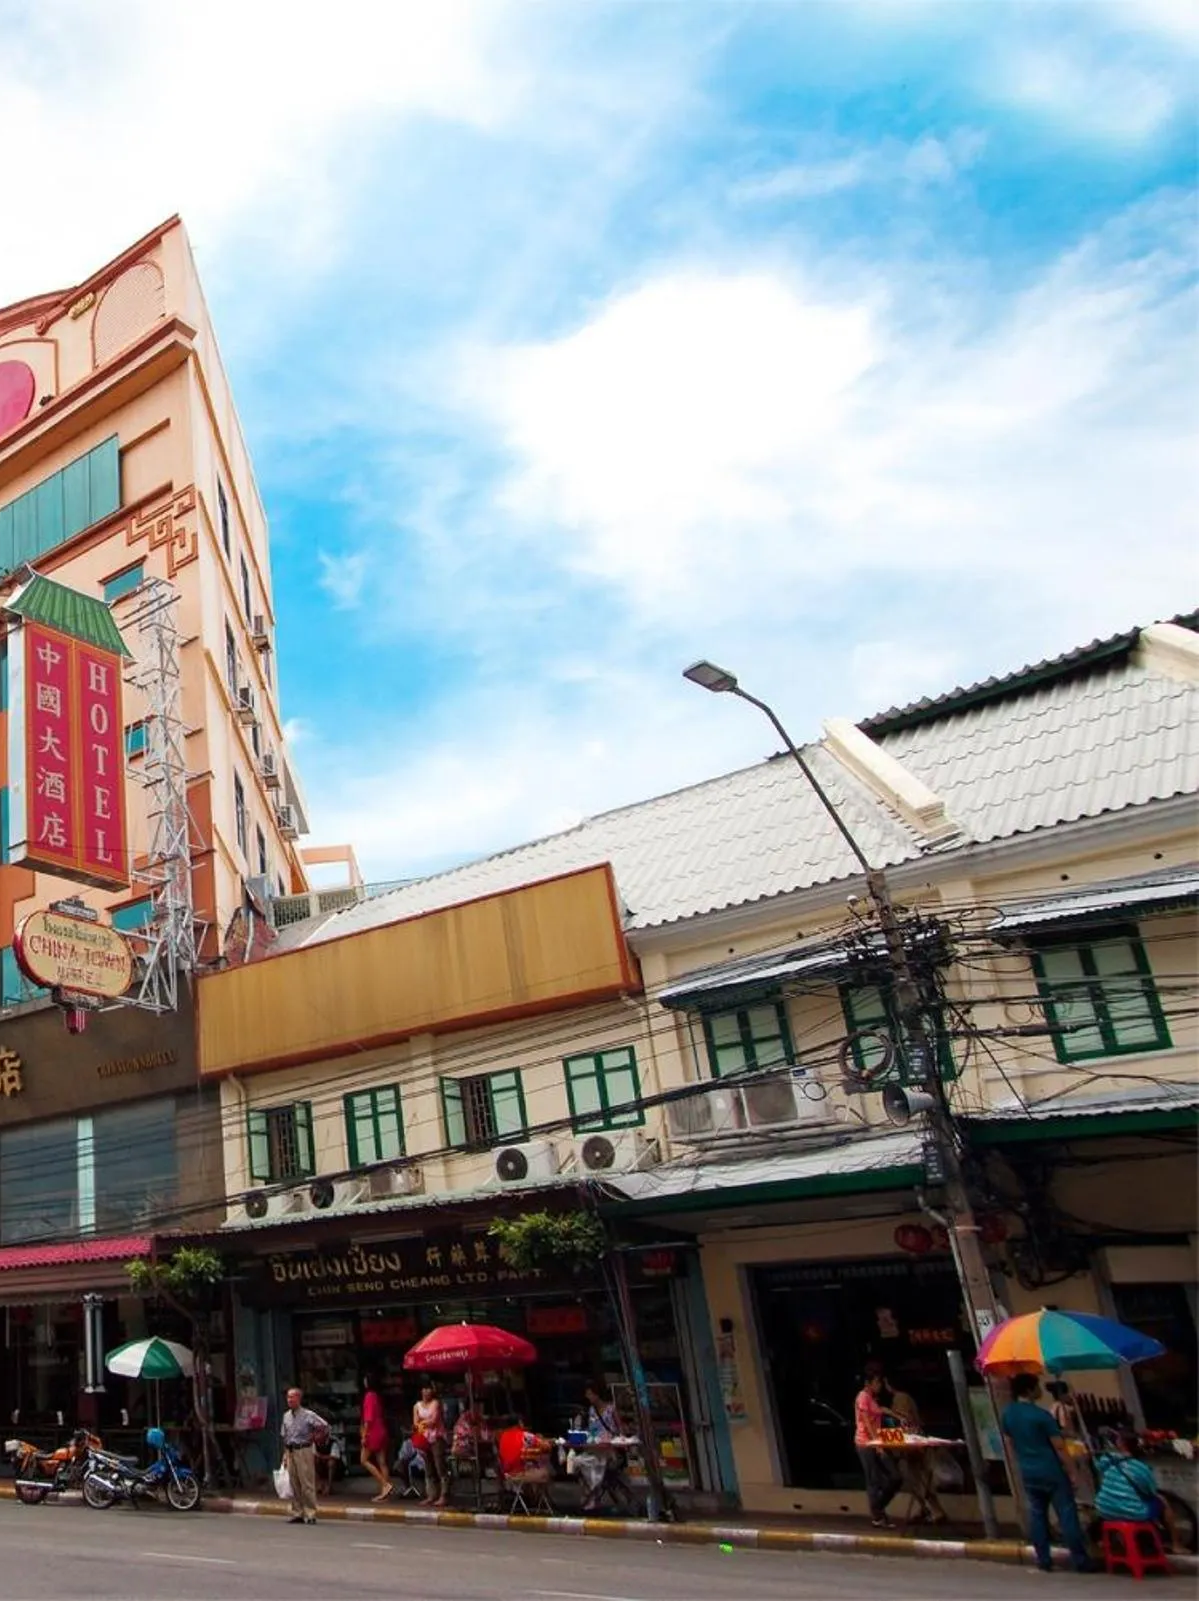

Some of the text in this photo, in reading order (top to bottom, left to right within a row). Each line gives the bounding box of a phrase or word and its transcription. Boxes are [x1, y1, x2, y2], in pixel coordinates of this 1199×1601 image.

[36, 641, 67, 849] 中國大酒店
[87, 660, 113, 863] HOTEL
